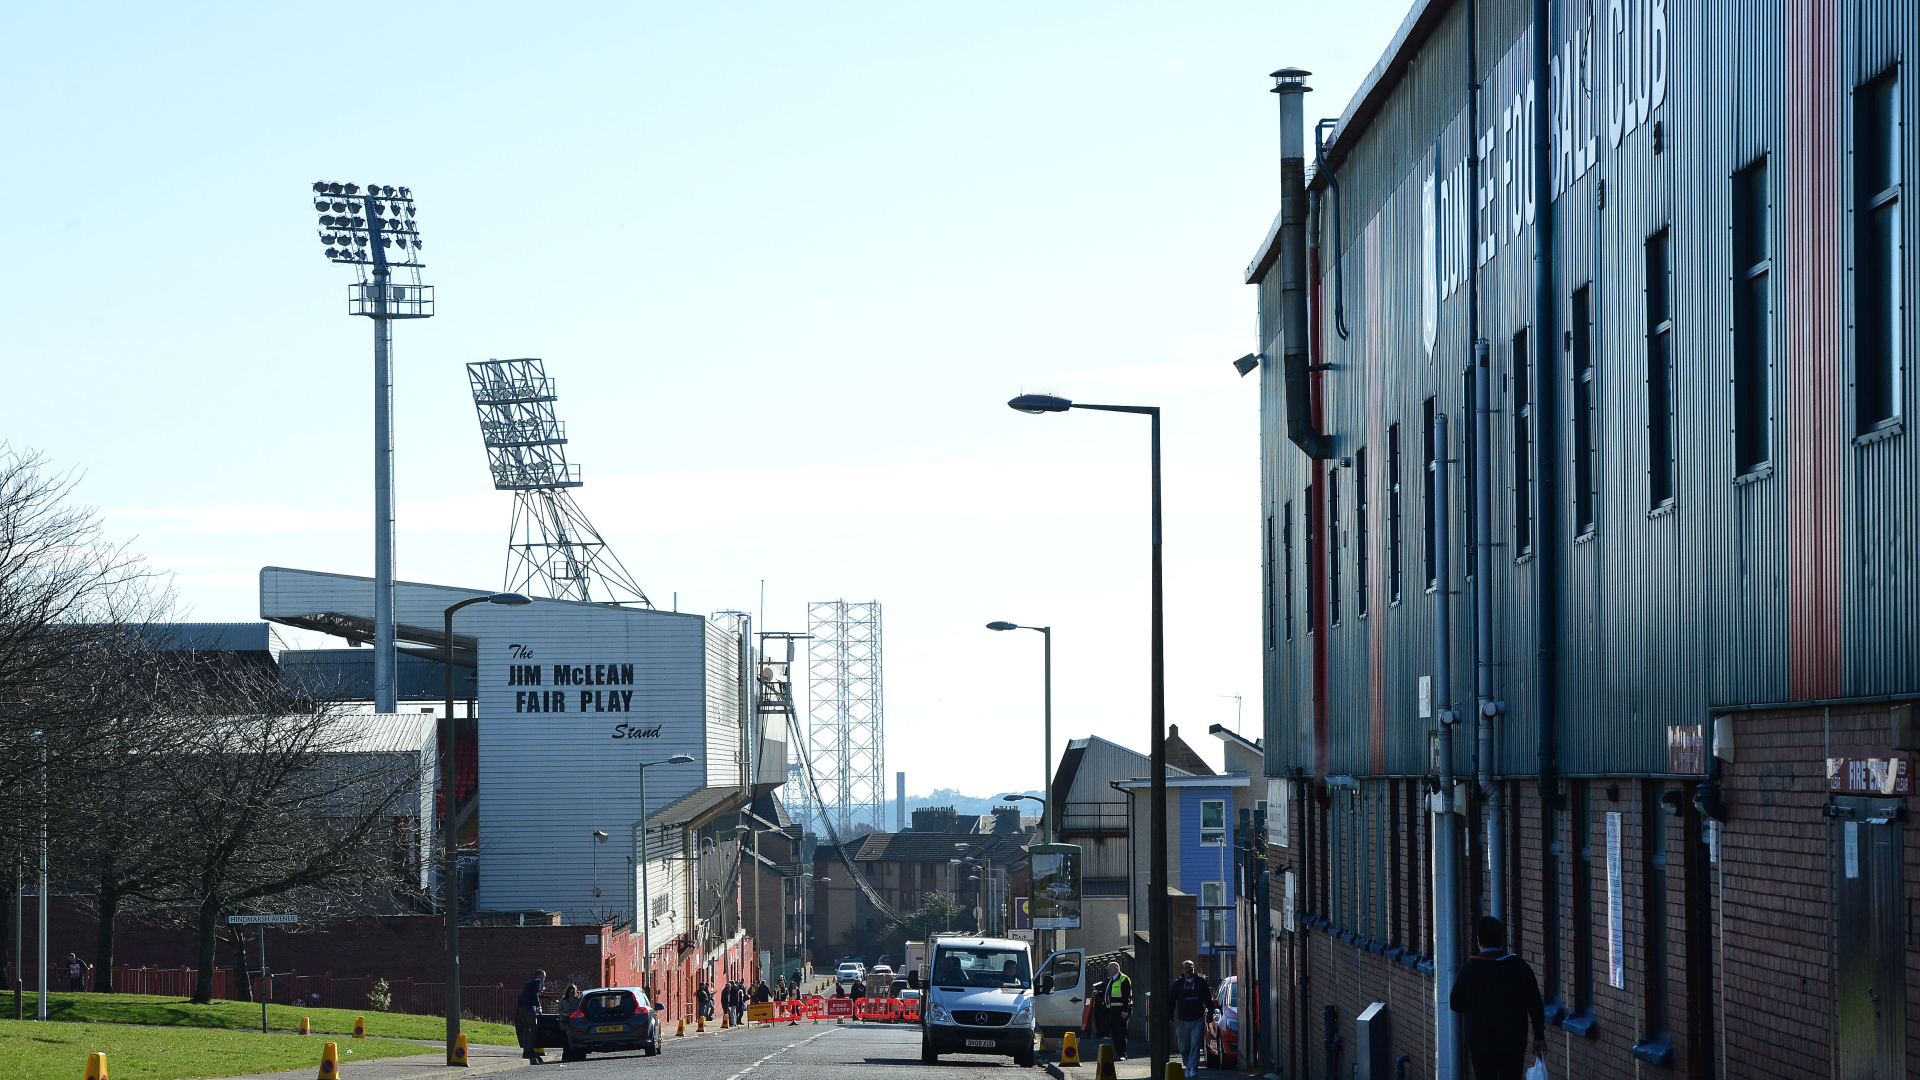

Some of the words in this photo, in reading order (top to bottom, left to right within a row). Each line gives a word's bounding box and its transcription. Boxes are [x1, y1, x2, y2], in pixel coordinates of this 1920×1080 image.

[1441, 125, 1496, 303] DUNEE
[1503, 14, 1597, 247] FOOBALL
[1608, 0, 1667, 150] CLUB
[508, 643, 534, 660] The
[508, 665, 541, 686] JIM
[553, 664, 634, 686] McLEAN
[516, 691, 565, 713] FAIR
[580, 690, 633, 713] PLAY
[611, 723, 662, 739] Stand
[1849, 760, 1867, 790] FIRE
